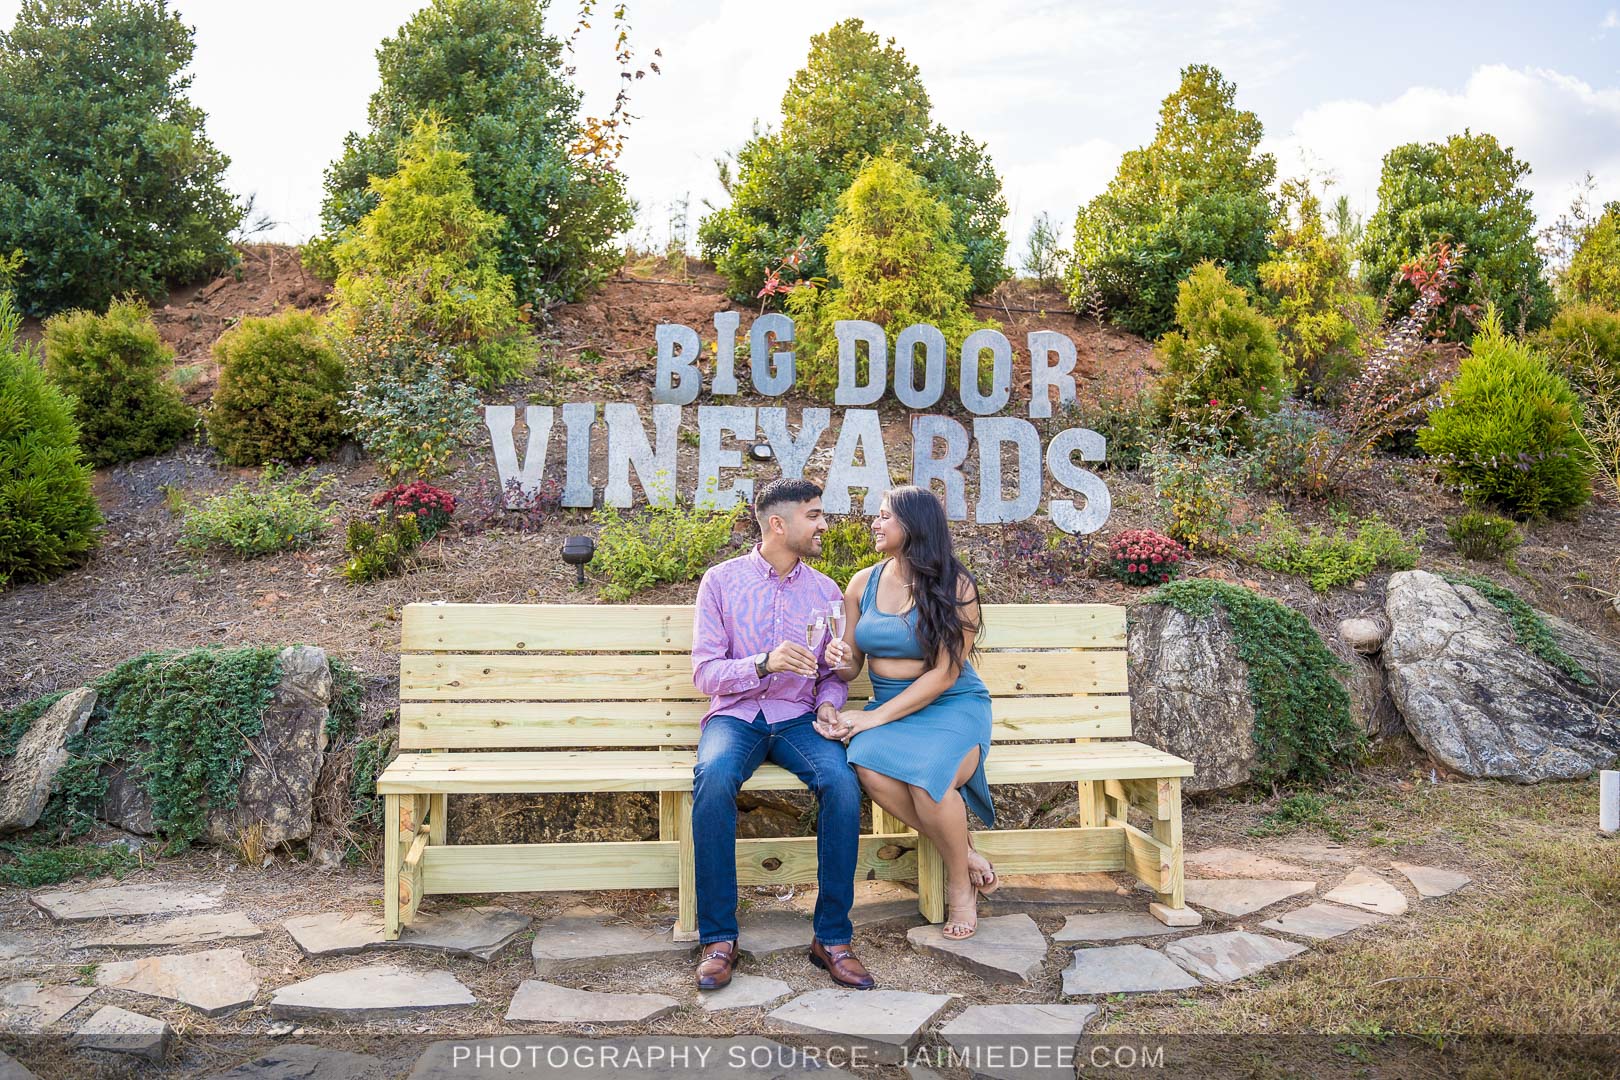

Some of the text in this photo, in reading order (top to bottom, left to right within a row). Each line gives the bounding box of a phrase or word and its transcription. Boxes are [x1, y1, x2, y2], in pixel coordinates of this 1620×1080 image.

[652, 311, 1077, 418] BIG DOOR
[485, 402, 1111, 535] VINEYARDS
